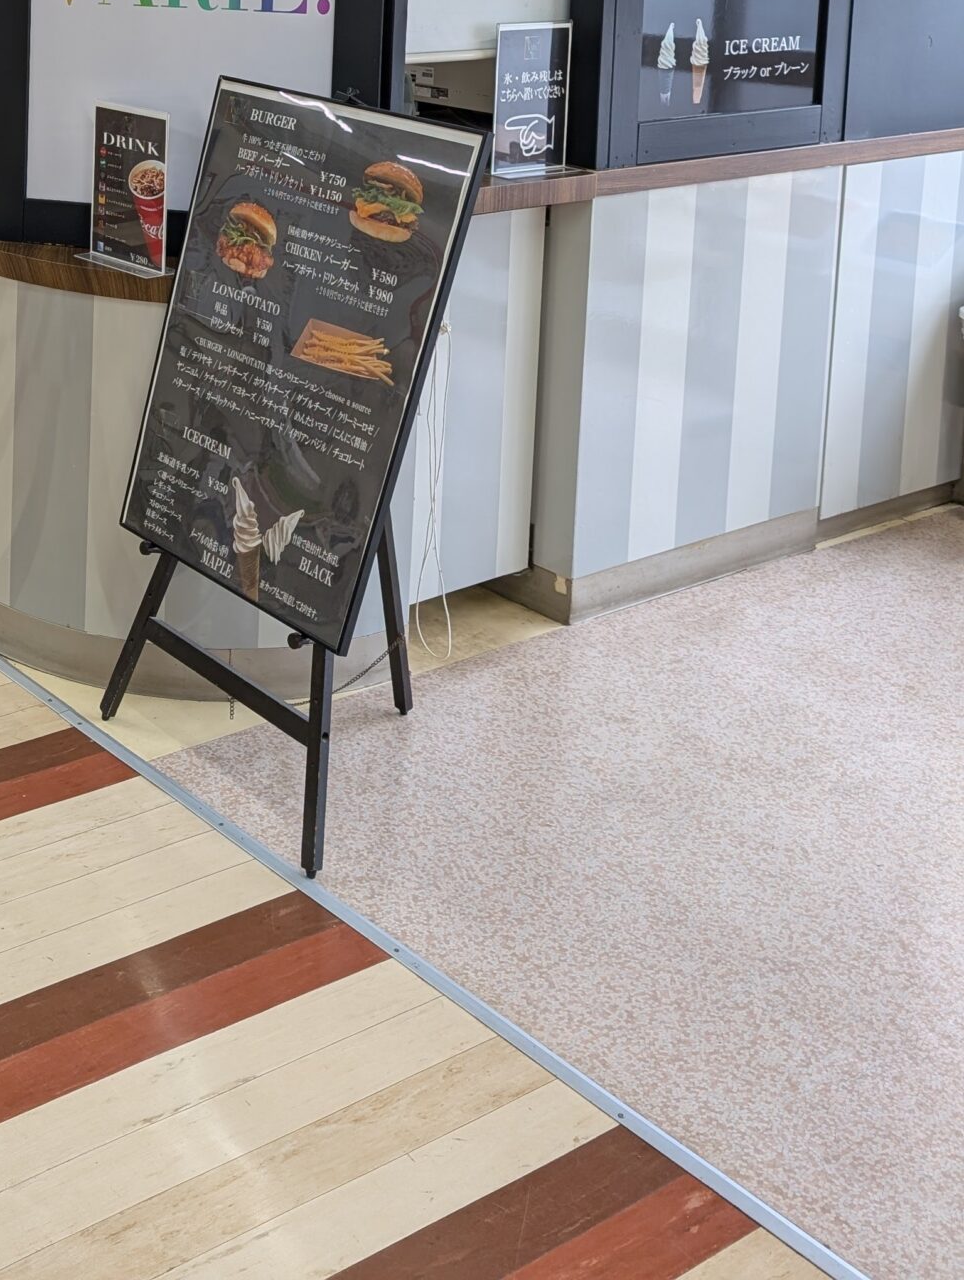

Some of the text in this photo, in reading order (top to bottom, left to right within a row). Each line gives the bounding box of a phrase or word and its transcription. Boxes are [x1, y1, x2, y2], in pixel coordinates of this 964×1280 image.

[724, 36, 801, 56] ICE CREAM
[723, 62, 809, 81] ブラック or プレーン
[500, 85, 565, 103] こちらへ置いてください
[250, 108, 297, 131] BURGER
[103, 132, 159, 156] DRINK
[238, 147, 347, 187] BEEF バーガー ¥750
[130, 252, 148, 266] ¥280
[285, 241, 397, 287] CHICKEN バーガー ¥580
[212, 281, 280, 316] LONGPOTATO
[368, 285, 394, 304] ¥980
[214, 301, 273, 333] 単品 ¥550
[210, 315, 270, 347] ドリンクセット ¥700
[183, 426, 231, 459] ICECREAM
[208, 475, 229, 495] ¥350
[200, 550, 234, 579] MAPLE
[298, 556, 334, 587] BLACK
